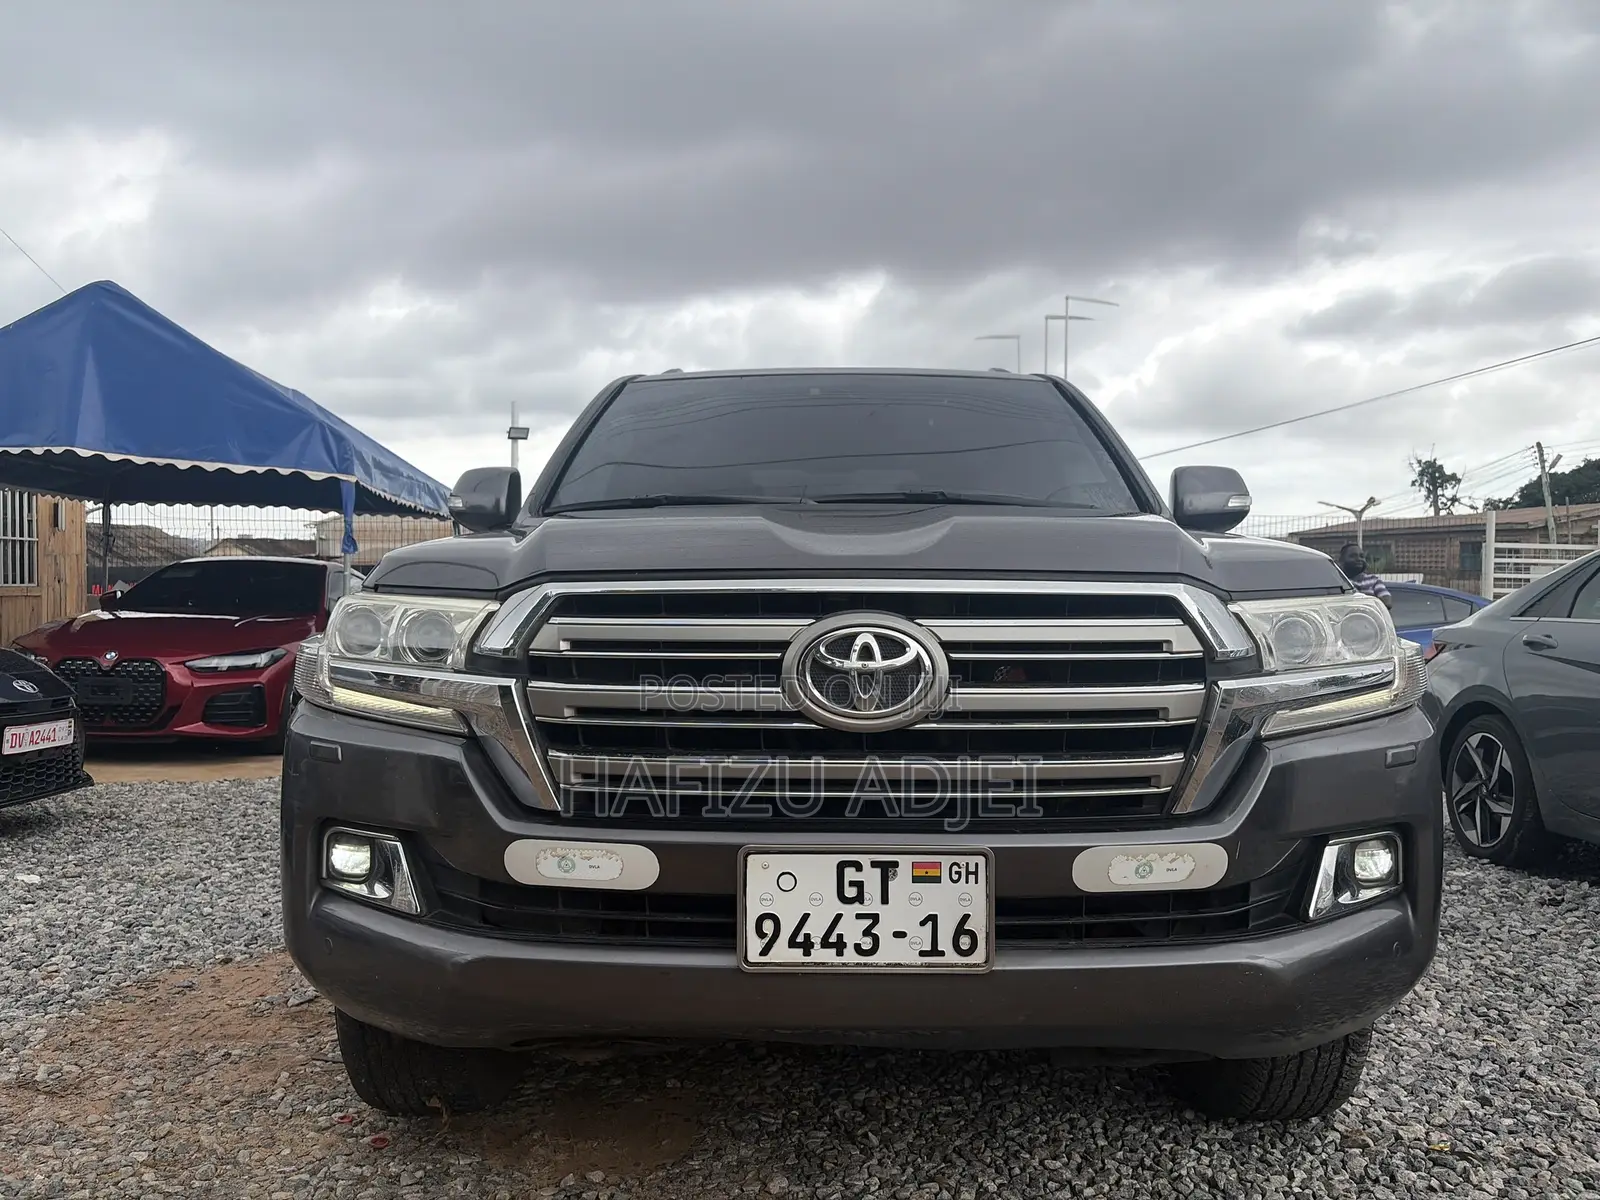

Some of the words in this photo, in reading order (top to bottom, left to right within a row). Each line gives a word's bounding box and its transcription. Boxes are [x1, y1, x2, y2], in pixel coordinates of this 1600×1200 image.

[9, 733, 25, 749] DV
[29, 727, 56, 745] A2441
[836, 860, 899, 905] GT
[948, 861, 979, 885] GH
